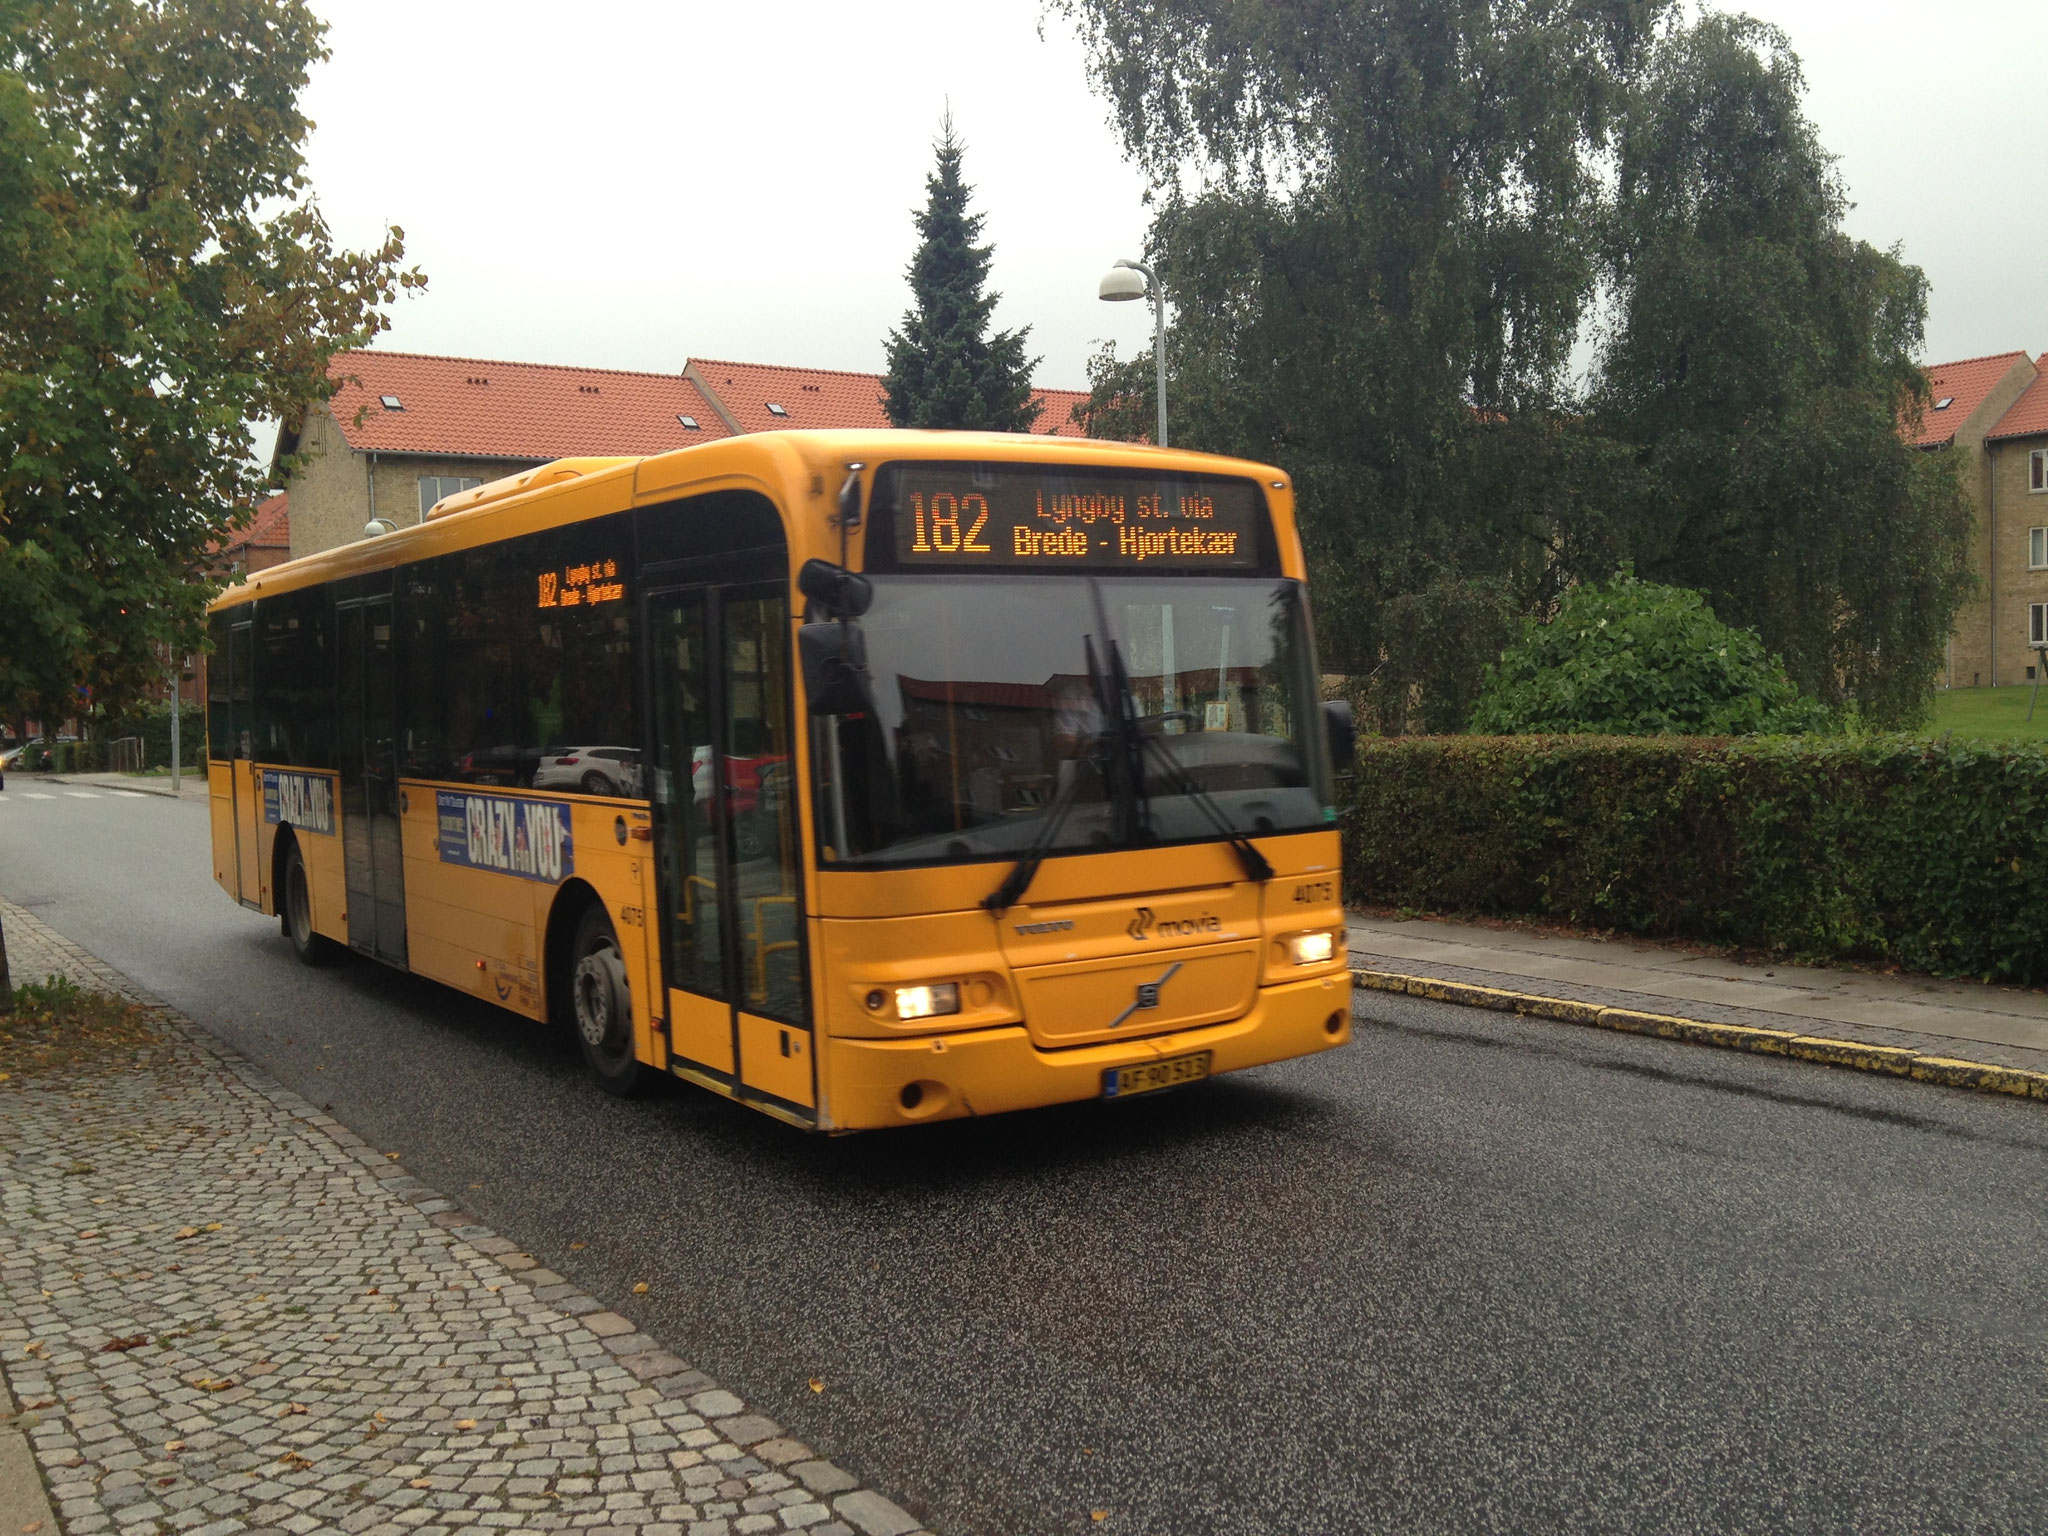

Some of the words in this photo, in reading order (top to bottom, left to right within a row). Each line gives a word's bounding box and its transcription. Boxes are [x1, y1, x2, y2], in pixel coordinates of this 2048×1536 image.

[909, 492, 990, 552] 182
[1035, 489, 1125, 524] Lyngby
[1138, 490, 1169, 518] st.
[1180, 491, 1214, 518] via
[1013, 525, 1088, 555] Brede
[1119, 526, 1238, 560] Hjortekær
[538, 572, 557, 608] 182
[466, 796, 516, 870] CRAZY
[523, 803, 562, 880] YOU
[1157, 912, 1222, 937] movia
